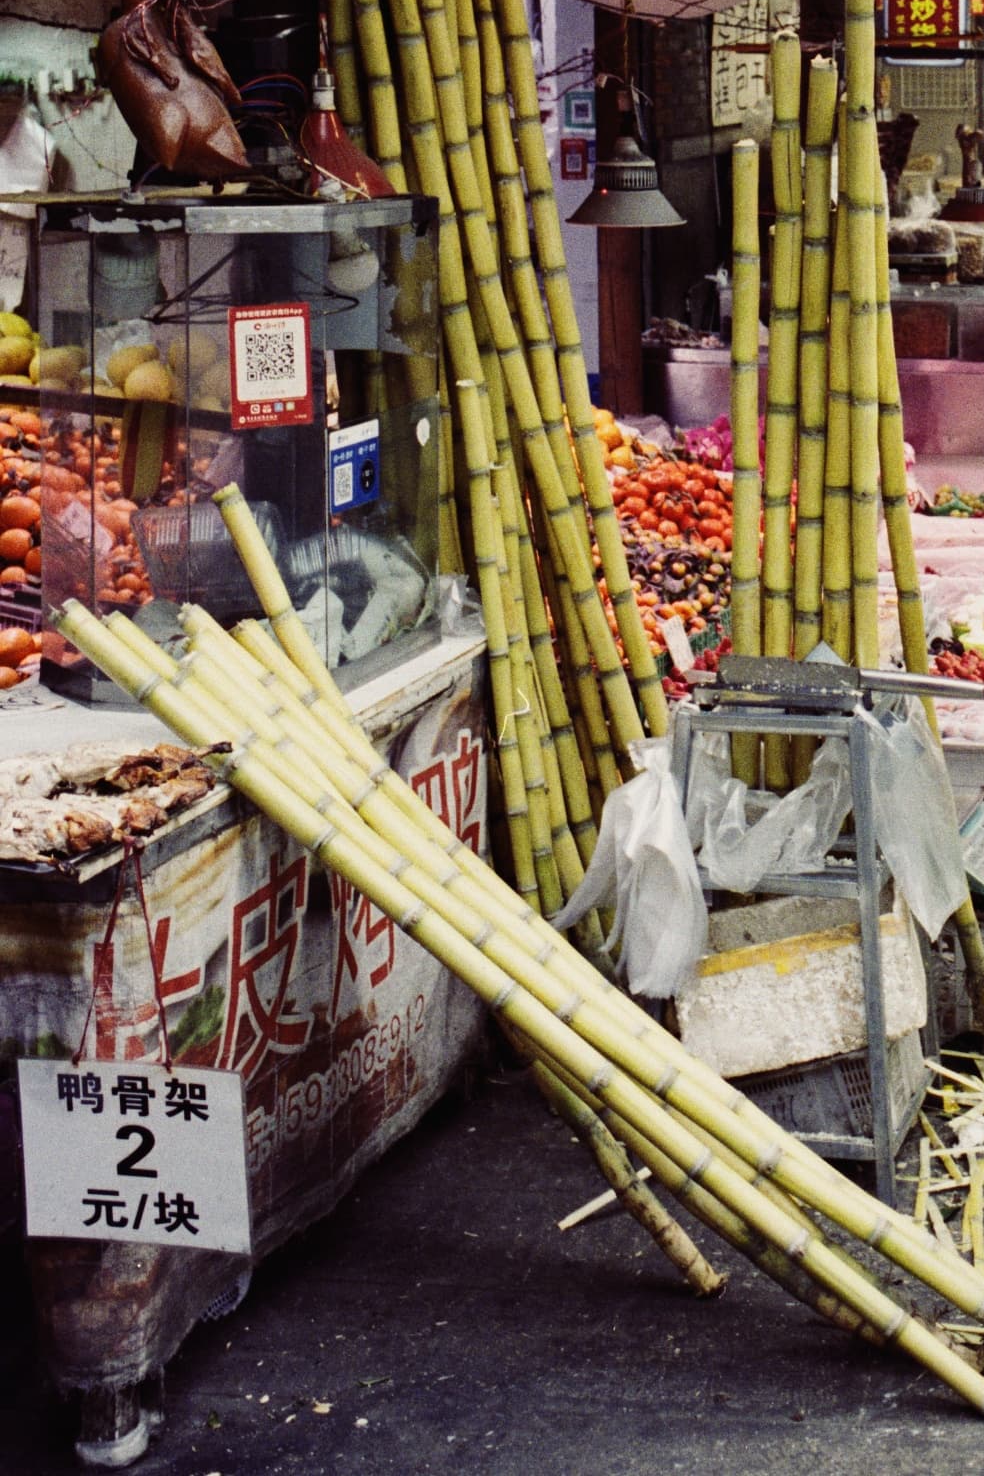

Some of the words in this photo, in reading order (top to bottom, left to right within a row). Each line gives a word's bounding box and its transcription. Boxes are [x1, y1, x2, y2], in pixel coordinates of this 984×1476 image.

[57, 1072, 209, 1121] 鸭骨架
[115, 1124, 158, 1179] 2
[82, 1188, 200, 1235] 元/块
